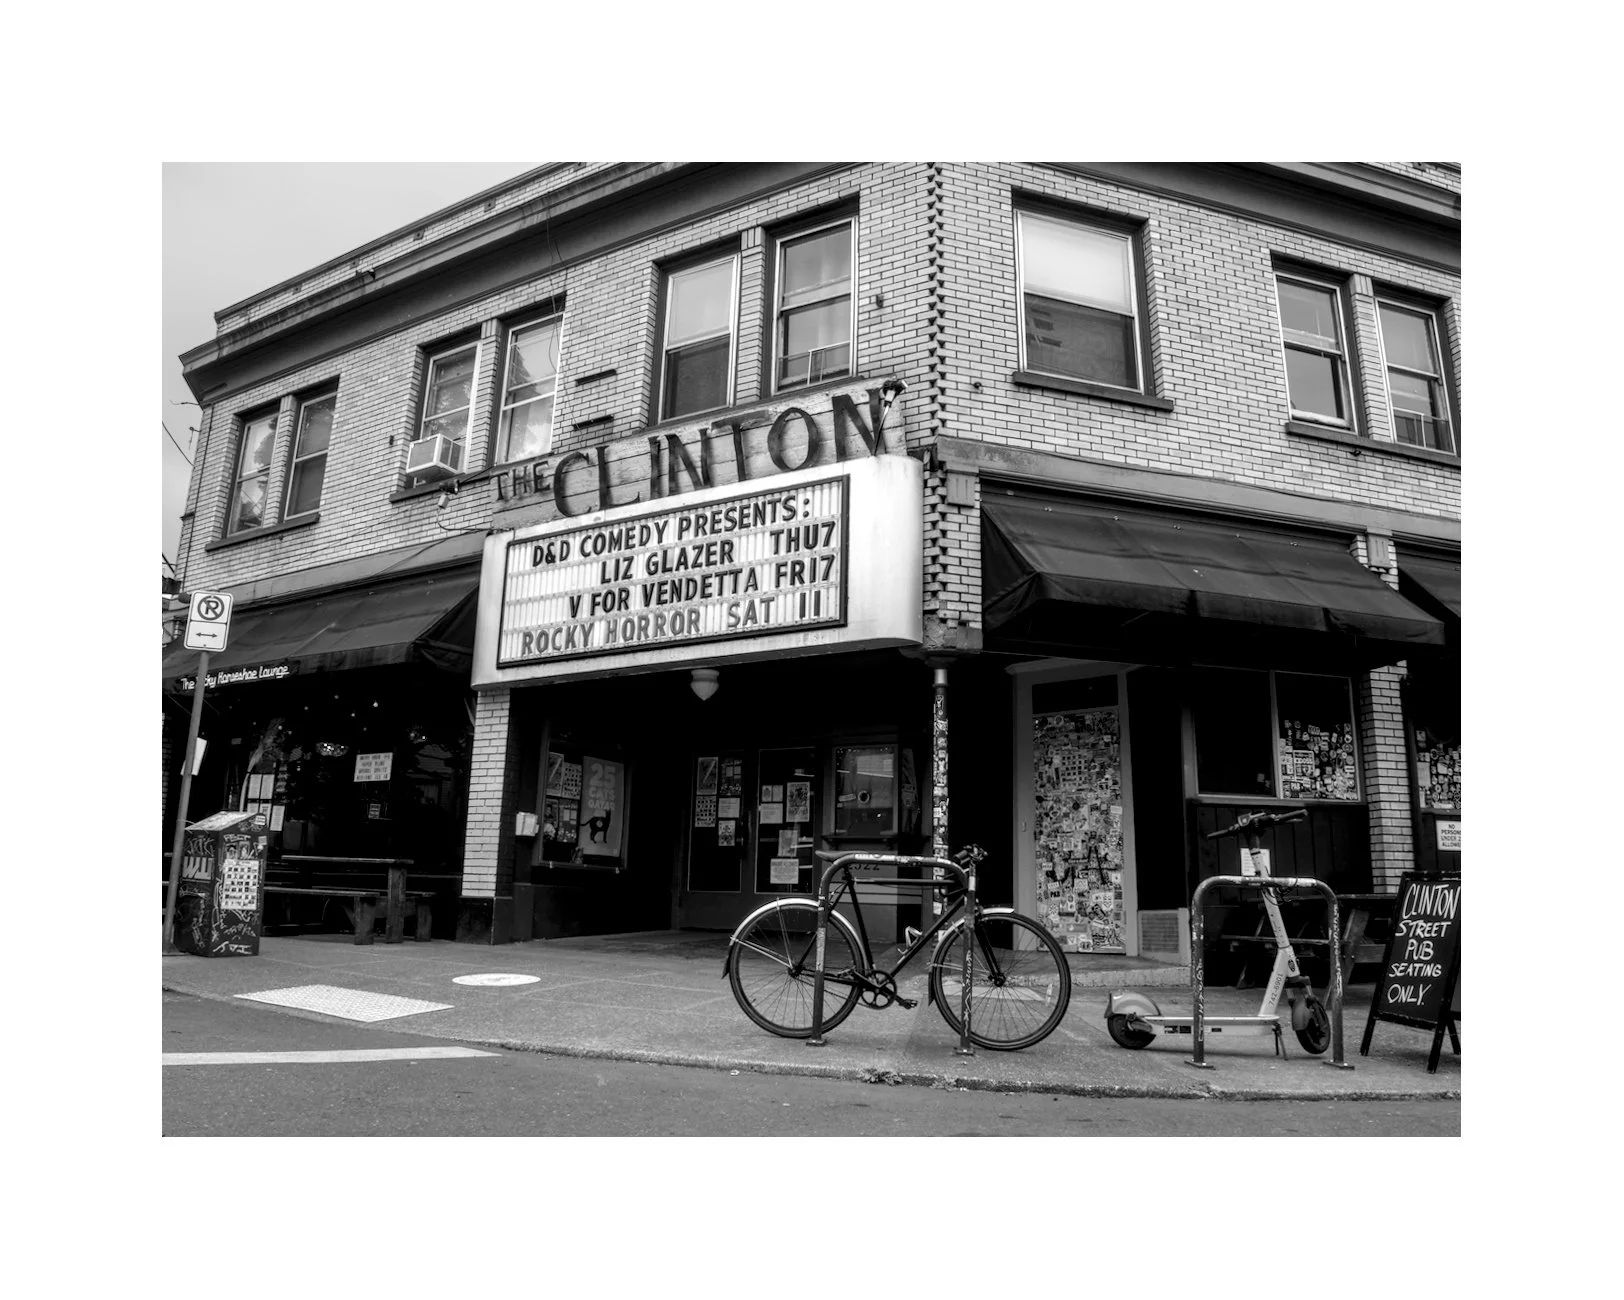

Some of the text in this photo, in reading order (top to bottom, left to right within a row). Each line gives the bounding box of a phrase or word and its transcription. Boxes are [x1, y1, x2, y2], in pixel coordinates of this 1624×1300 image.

[492, 387, 886, 517] THE CLINTON
[532, 495, 811, 567] D&D COMEDY PRESENTS:
[600, 556, 635, 585] LIZ
[645, 539, 734, 576] GLAZER
[569, 594, 582, 618] V
[590, 587, 630, 616] FOR
[641, 566, 759, 608] VENDETTA
[522, 622, 594, 656] ROCKY
[605, 607, 700, 644] HORROR
[727, 596, 775, 628] SAT
[180, 677, 195, 690] The
[259, 665, 290, 679] Lounge
[589, 763, 616, 789] 25
[588, 786, 616, 801] CATS
[1402, 883, 1461, 919] CLINTON
[1395, 920, 1452, 938] STREET
[1405, 938, 1434, 960] PUB
[1389, 963, 1442, 977] SEATING
[1387, 984, 1432, 1006] ONLY.
